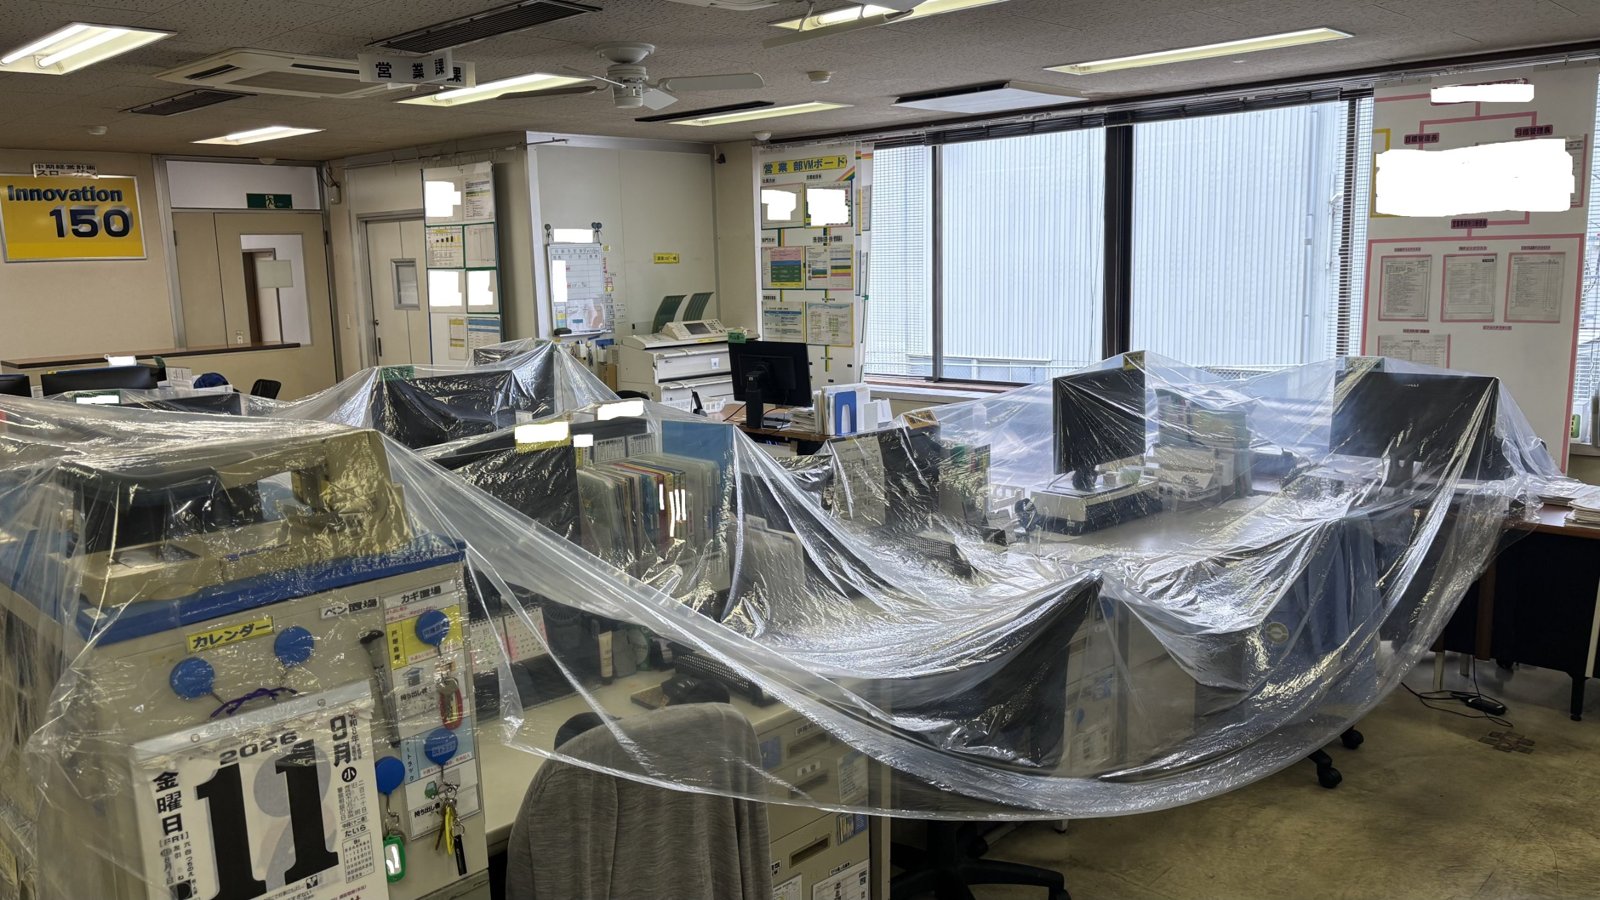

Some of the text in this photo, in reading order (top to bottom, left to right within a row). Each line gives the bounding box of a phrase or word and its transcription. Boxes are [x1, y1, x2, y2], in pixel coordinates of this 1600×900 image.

[375, 58, 445, 79] 営業課
[763, 157, 846, 175] 営業部VMボード
[7, 185, 123, 202] Innovation
[49, 207, 131, 238] 150
[401, 585, 442, 604] カギ置場
[324, 598, 378, 616] ペン置場
[193, 623, 270, 649] カレンダー
[219, 731, 297, 766] 2026
[330, 715, 351, 767] 9月
[342, 768, 357, 782] 小
[152, 771, 183, 836] 金曜日
[358, 780, 367, 813] 二百二十日
[196, 739, 339, 900] 11
[345, 824, 367, 837] たいら
